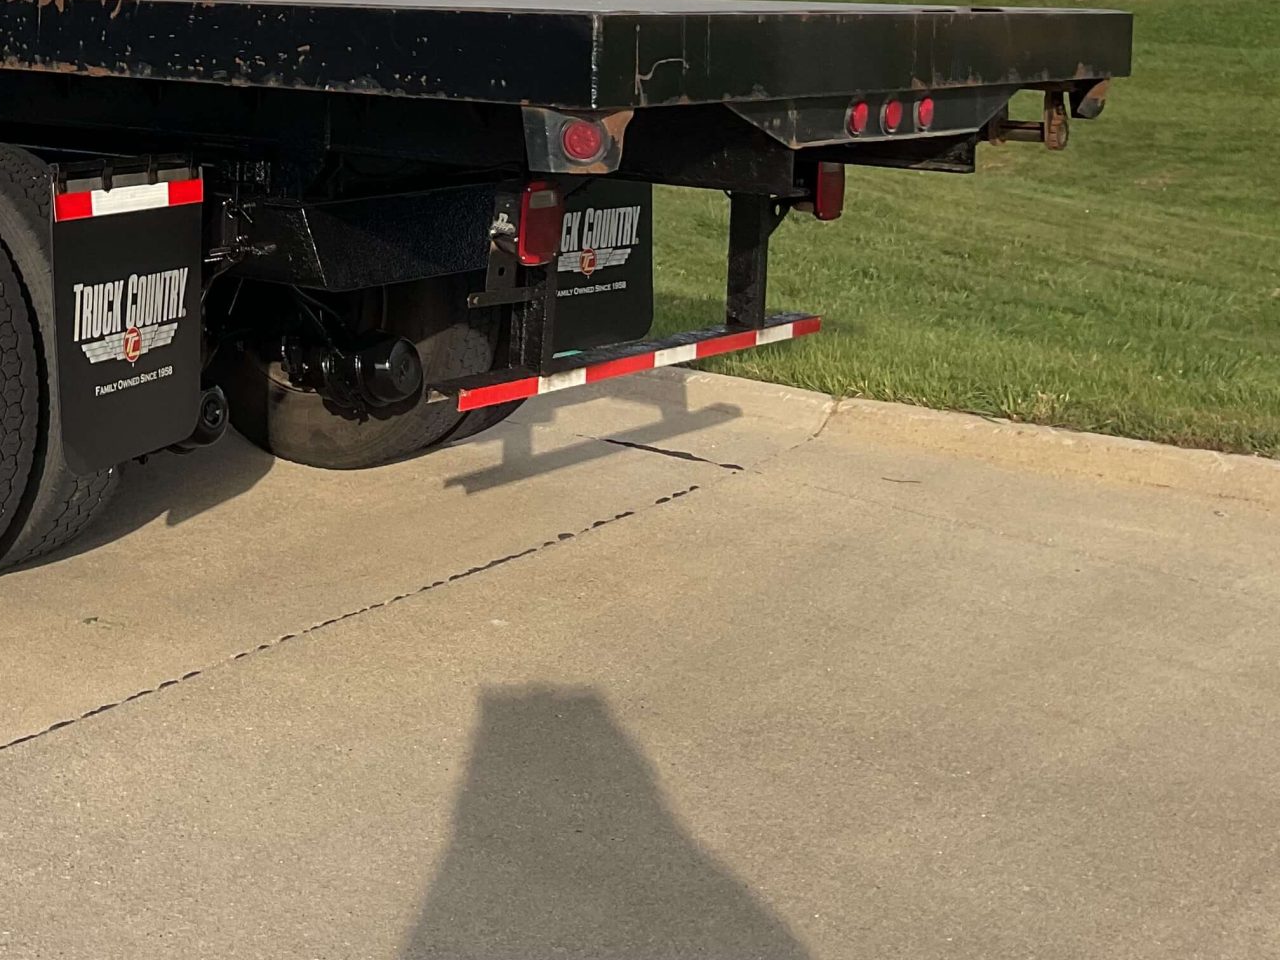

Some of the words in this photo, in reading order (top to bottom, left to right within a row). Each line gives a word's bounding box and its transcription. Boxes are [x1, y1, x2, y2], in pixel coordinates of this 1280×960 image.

[582, 205, 640, 249] COUNTRY
[73, 280, 124, 342] TRUCK
[126, 267, 188, 329] COUNTRY
[556, 289, 573, 297] AMILY
[95, 382, 117, 396] FAMILY
[118, 376, 139, 390] OWNED
[140, 371, 157, 384] SINCE
[158, 366, 173, 378] 1958
